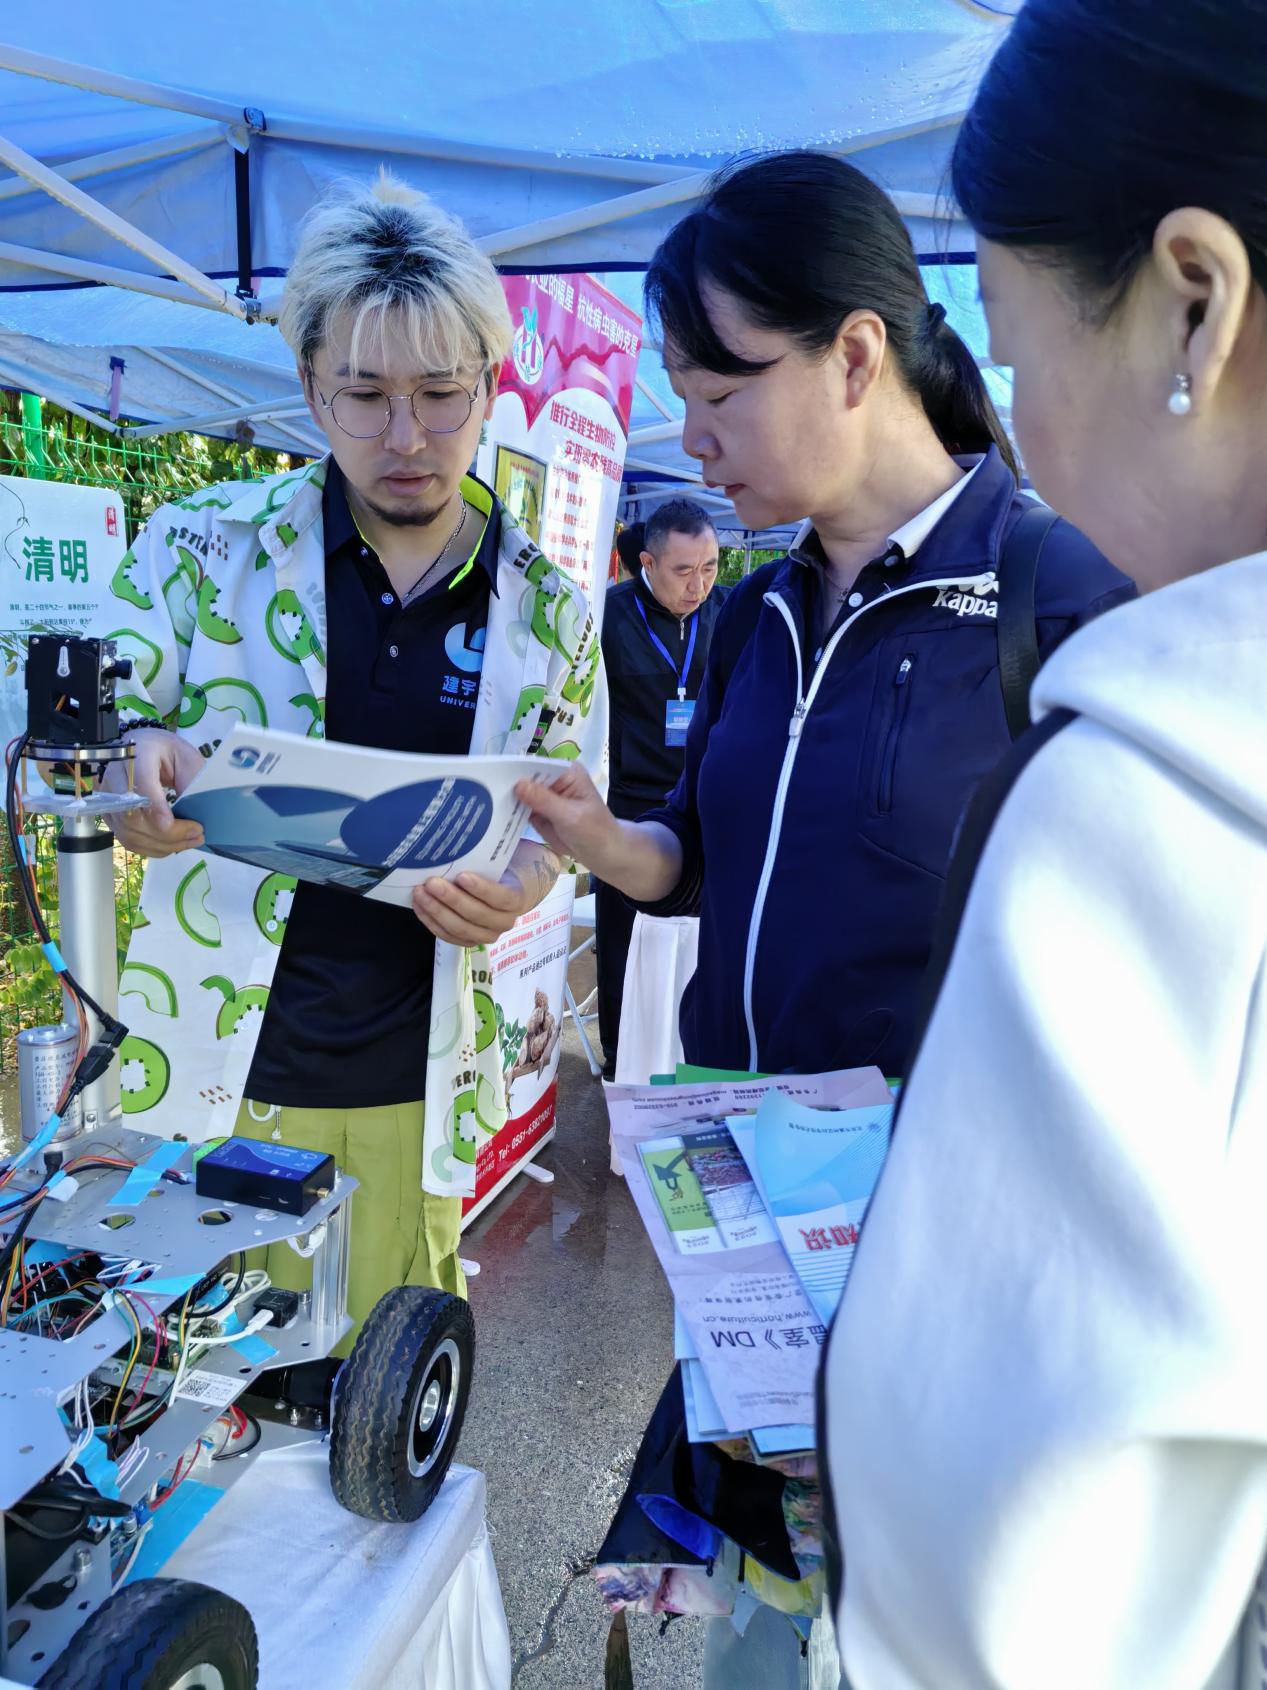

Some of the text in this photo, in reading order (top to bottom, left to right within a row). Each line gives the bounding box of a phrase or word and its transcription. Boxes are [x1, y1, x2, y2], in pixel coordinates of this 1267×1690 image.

[22, 535, 89, 584] 清明
[931, 589, 998, 618] Kappa
[710, 1330, 756, 1348] DM
